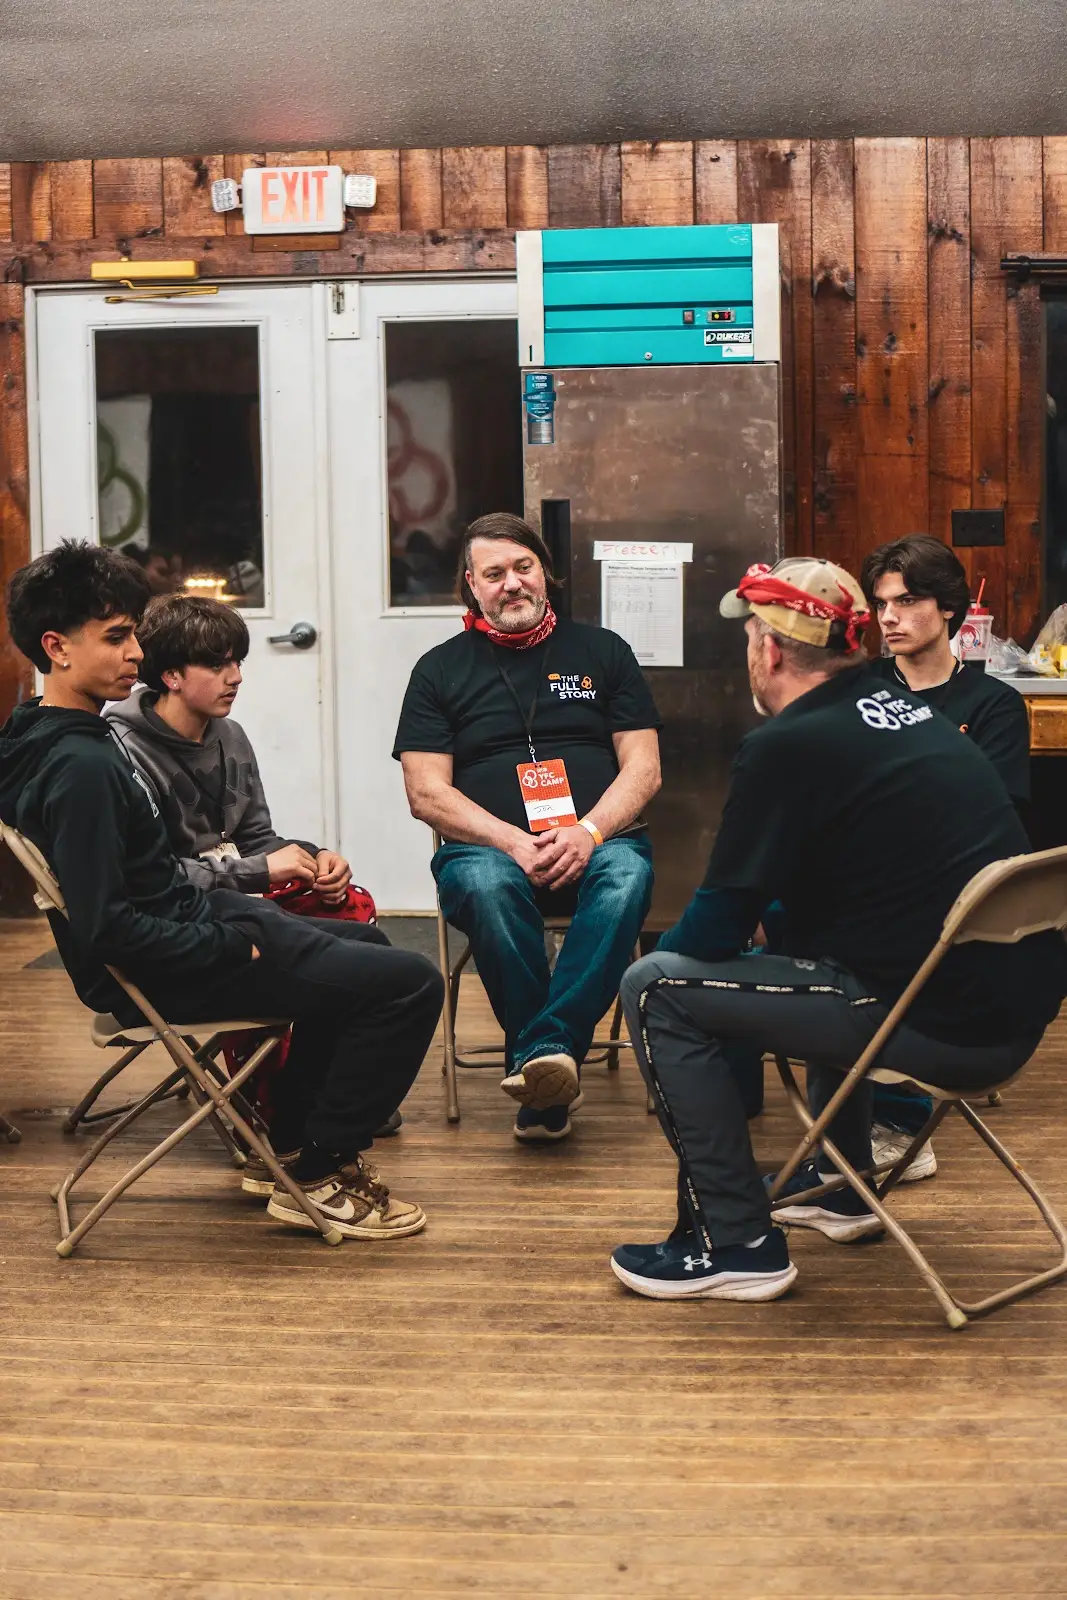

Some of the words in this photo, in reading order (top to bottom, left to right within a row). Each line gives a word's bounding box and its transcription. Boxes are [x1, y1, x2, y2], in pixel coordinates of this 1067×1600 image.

[260, 170, 329, 224] EXIT
[550, 682, 580, 692] FULL
[559, 690, 597, 700] STORY
[538, 772, 555, 780] YFC
[540, 777, 565, 787] CAMP
